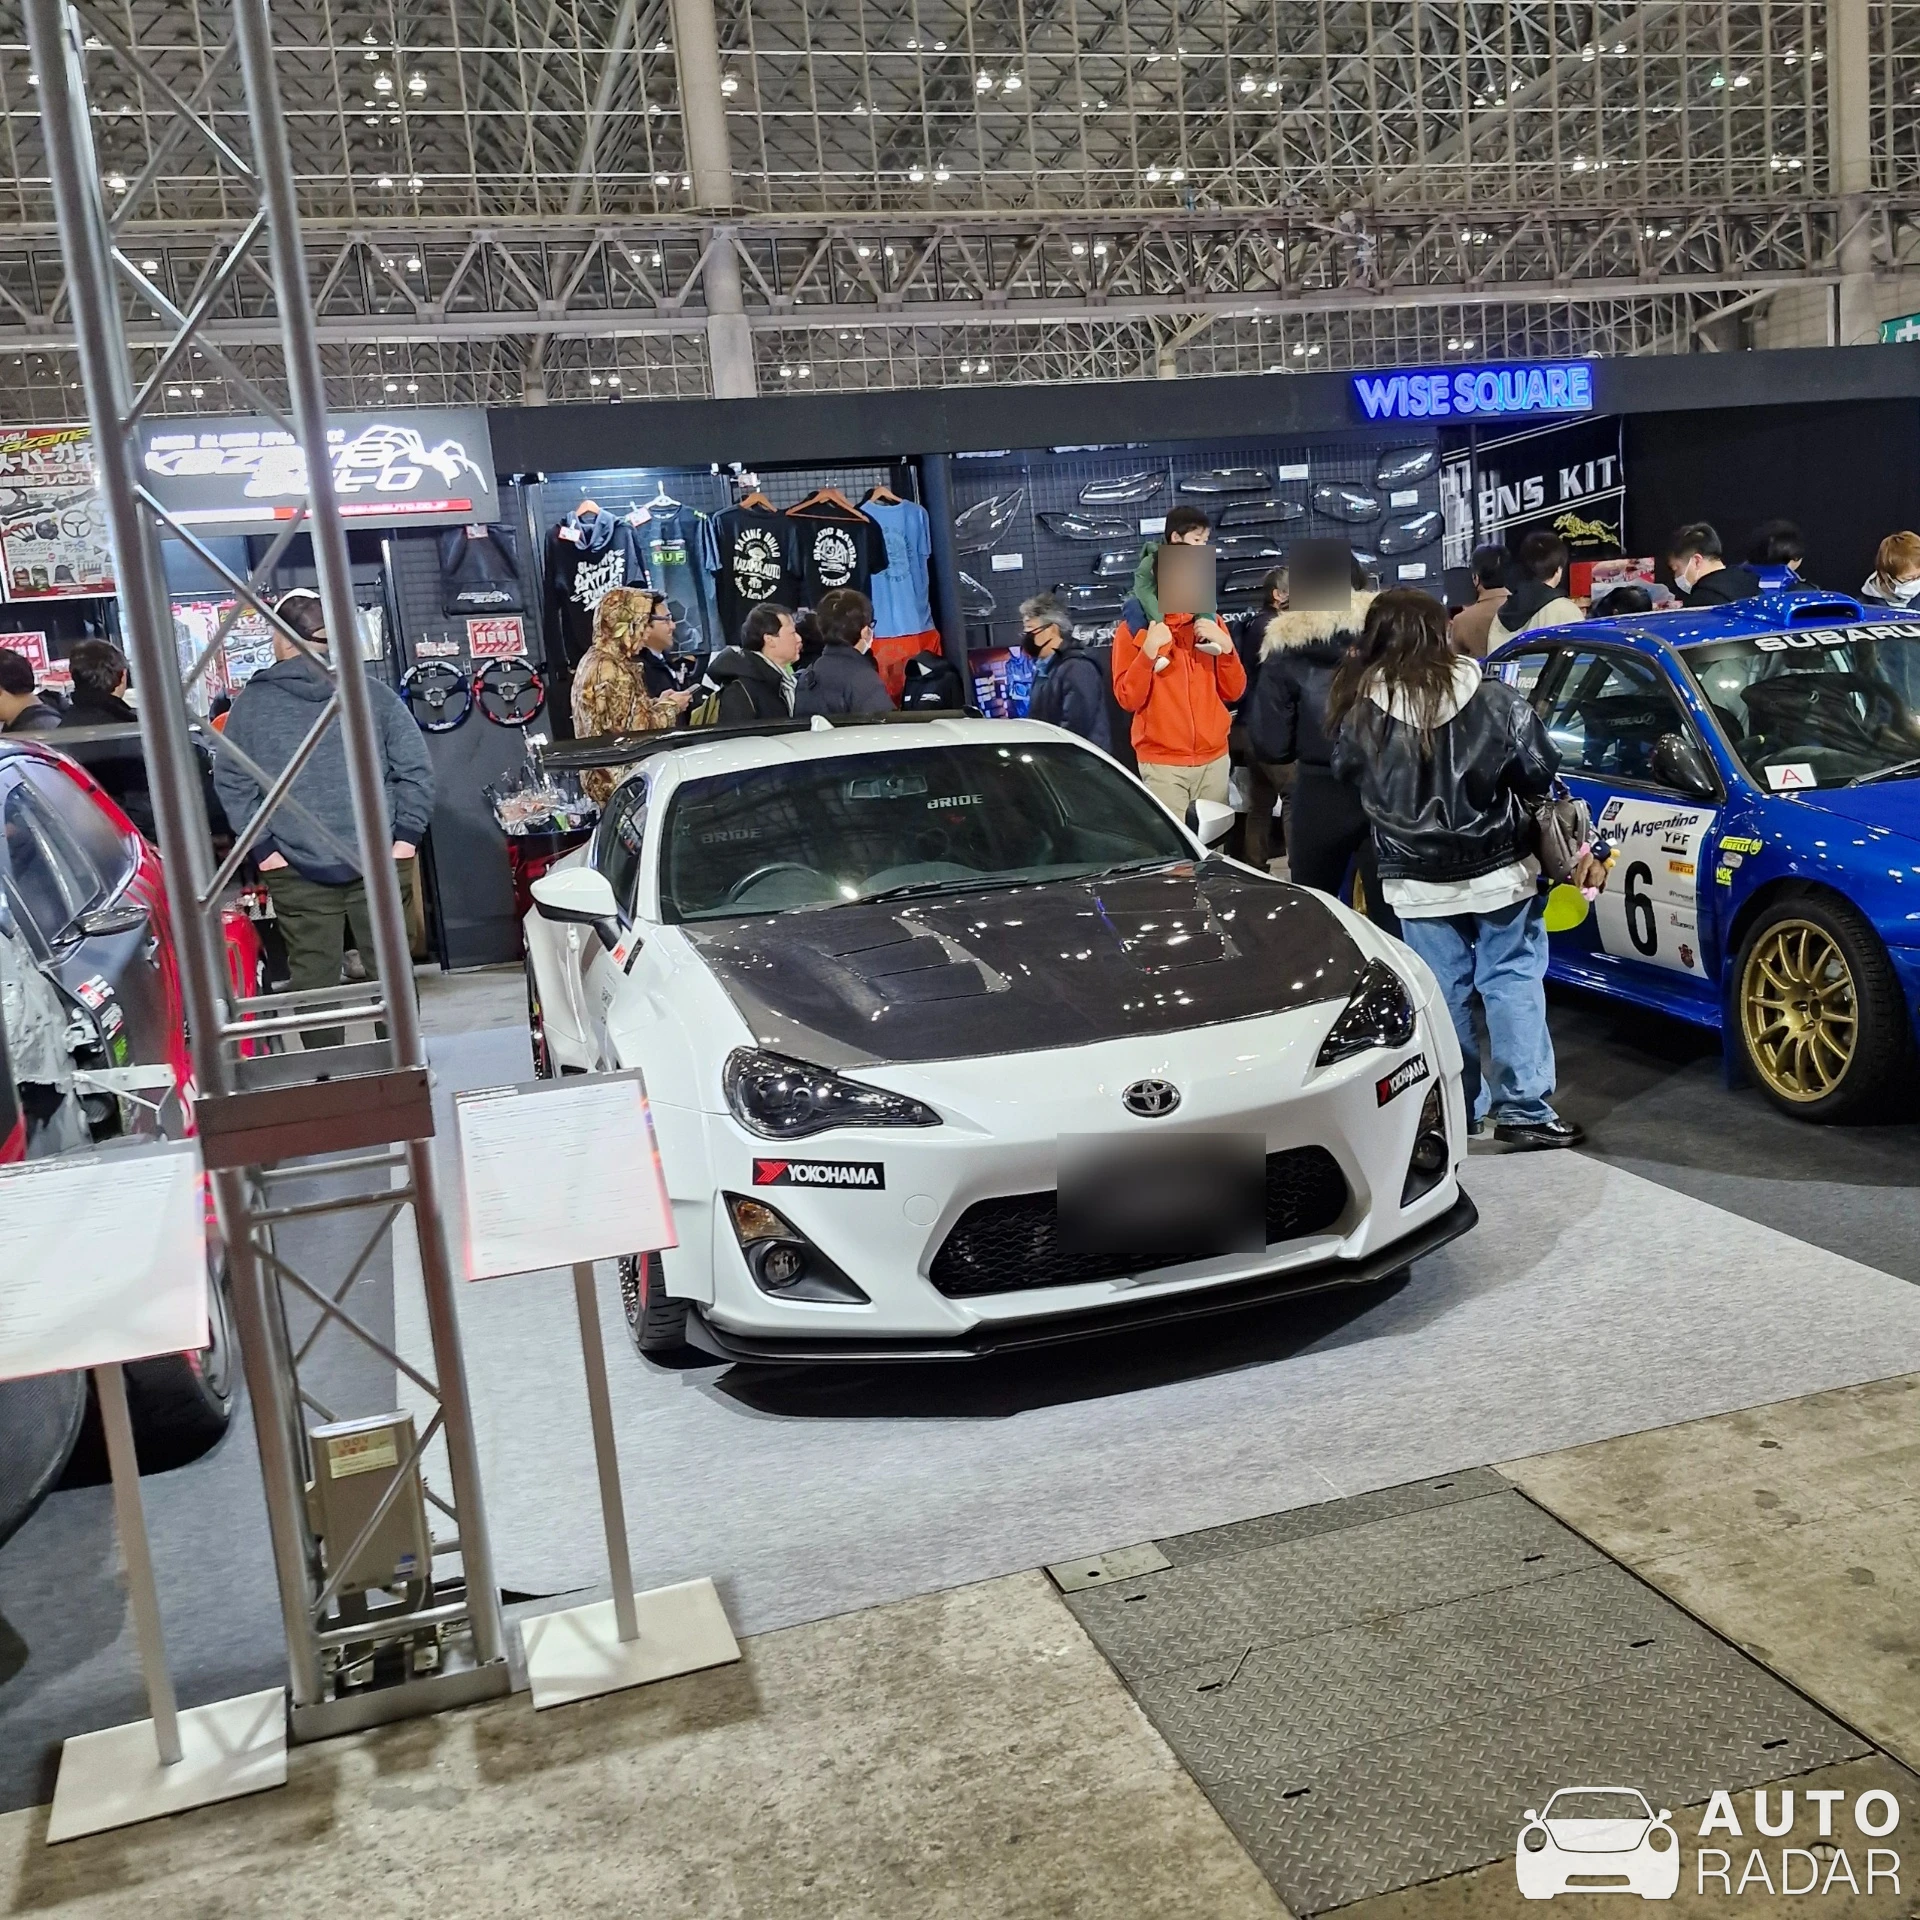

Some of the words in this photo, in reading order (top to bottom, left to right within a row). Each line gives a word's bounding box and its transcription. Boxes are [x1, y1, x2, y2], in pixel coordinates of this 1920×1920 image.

[1355, 375, 1451, 419] WISE
[1453, 366, 1591, 413] SQUARE
[1559, 455, 1617, 500] KIT
[1782, 768, 1804, 785] A
[926, 795, 984, 810] BRIDE
[702, 828, 762, 845] BRIDE
[1601, 823, 1629, 843] Rally
[1631, 812, 1699, 837] Argentina
[1664, 831, 1691, 846] YPF
[1716, 866, 1733, 881] NGK
[1624, 860, 1659, 958] 6
[1389, 1060, 1427, 1094] YOKOHAMA
[787, 1164, 879, 1185] YOKOHAMA
